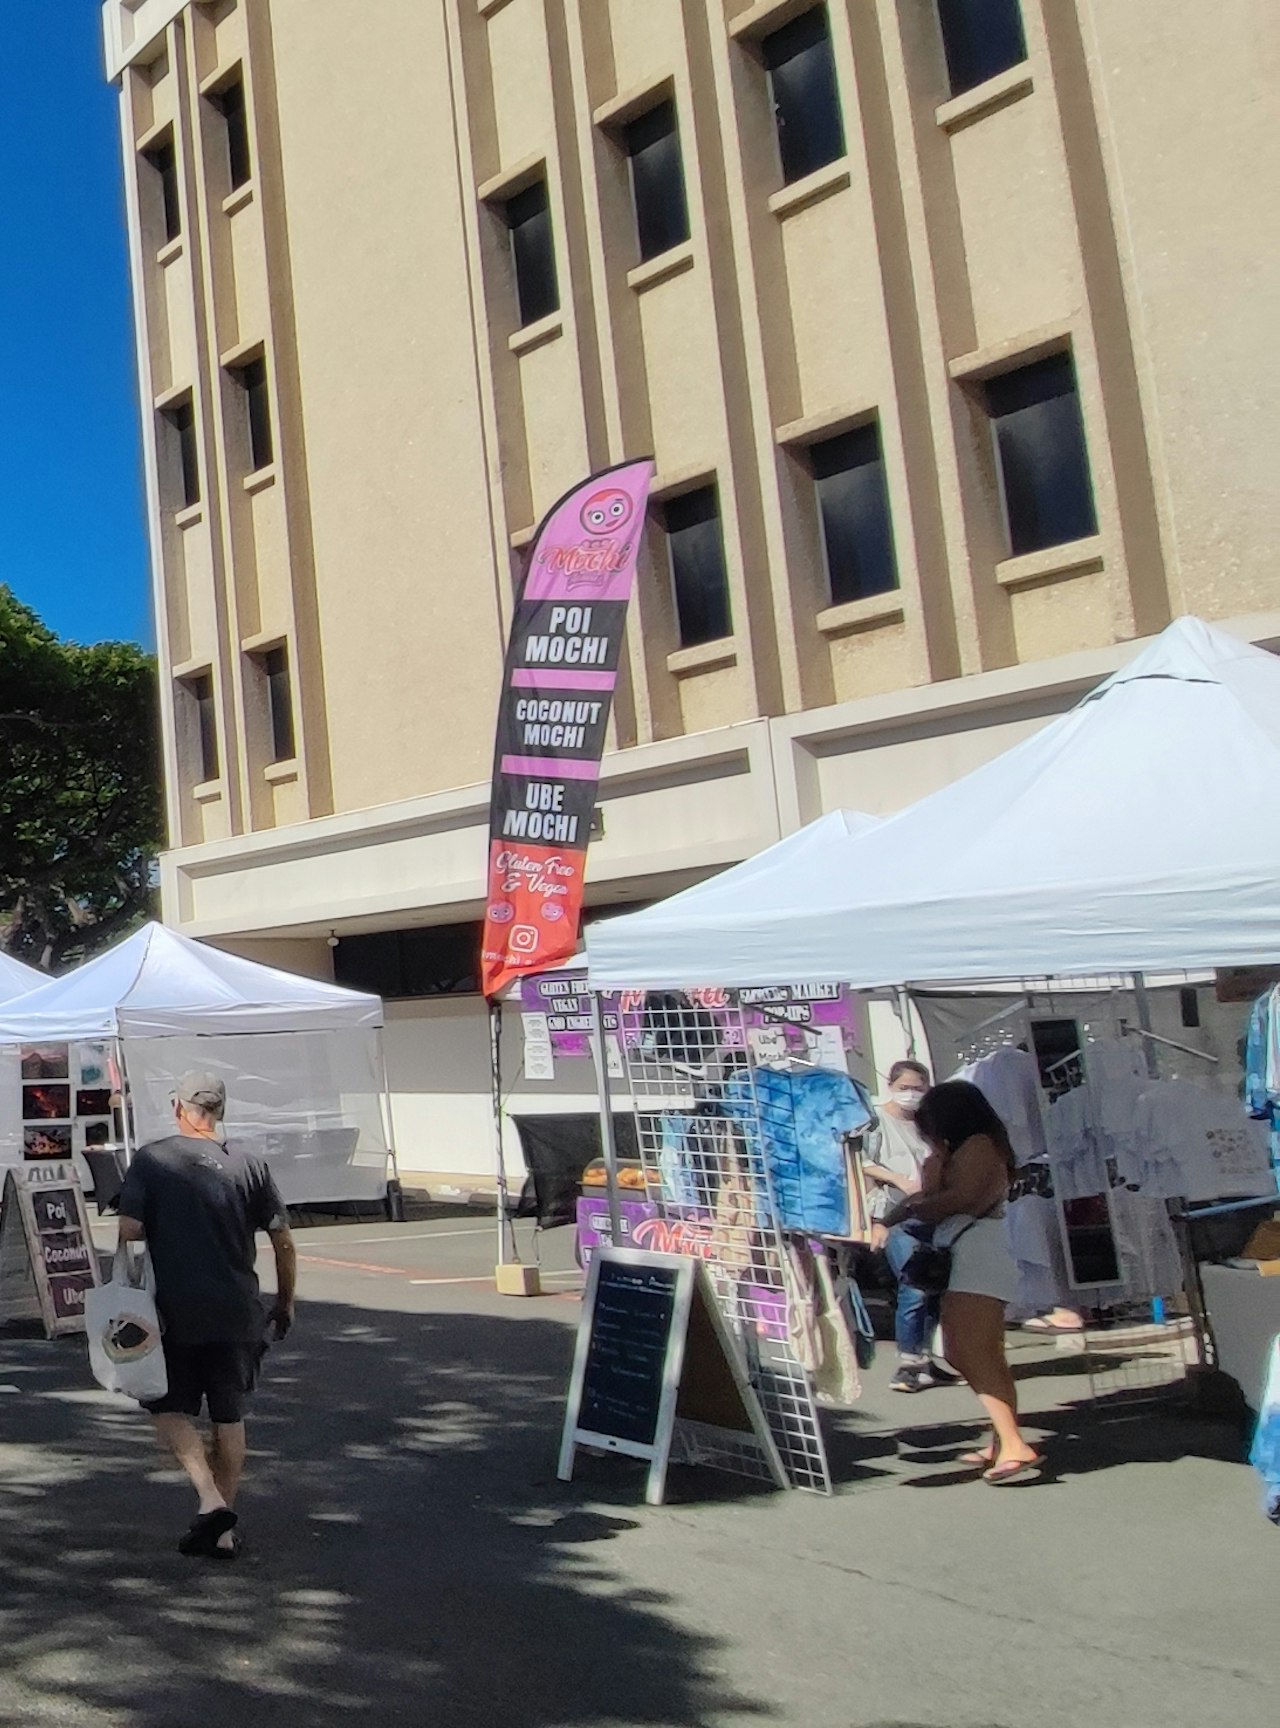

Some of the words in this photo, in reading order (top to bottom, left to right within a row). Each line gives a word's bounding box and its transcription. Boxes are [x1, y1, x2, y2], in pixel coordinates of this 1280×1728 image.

[537, 541, 633, 576] Mochi
[549, 606, 592, 634] POI
[525, 635, 608, 664] MOCHI
[516, 699, 602, 725] COCONUT
[524, 723, 585, 748] MOCHI
[525, 782, 565, 811] UBE
[503, 809, 578, 842] MOCHI
[496, 850, 543, 874] Gluten
[544, 856, 575, 876] Free
[501, 872, 522, 892] &
[791, 982, 838, 1000] MARKET
[46, 1202, 66, 1220] Poi
[44, 1245, 88, 1263] Coconut
[62, 1288, 85, 1306] Ube
